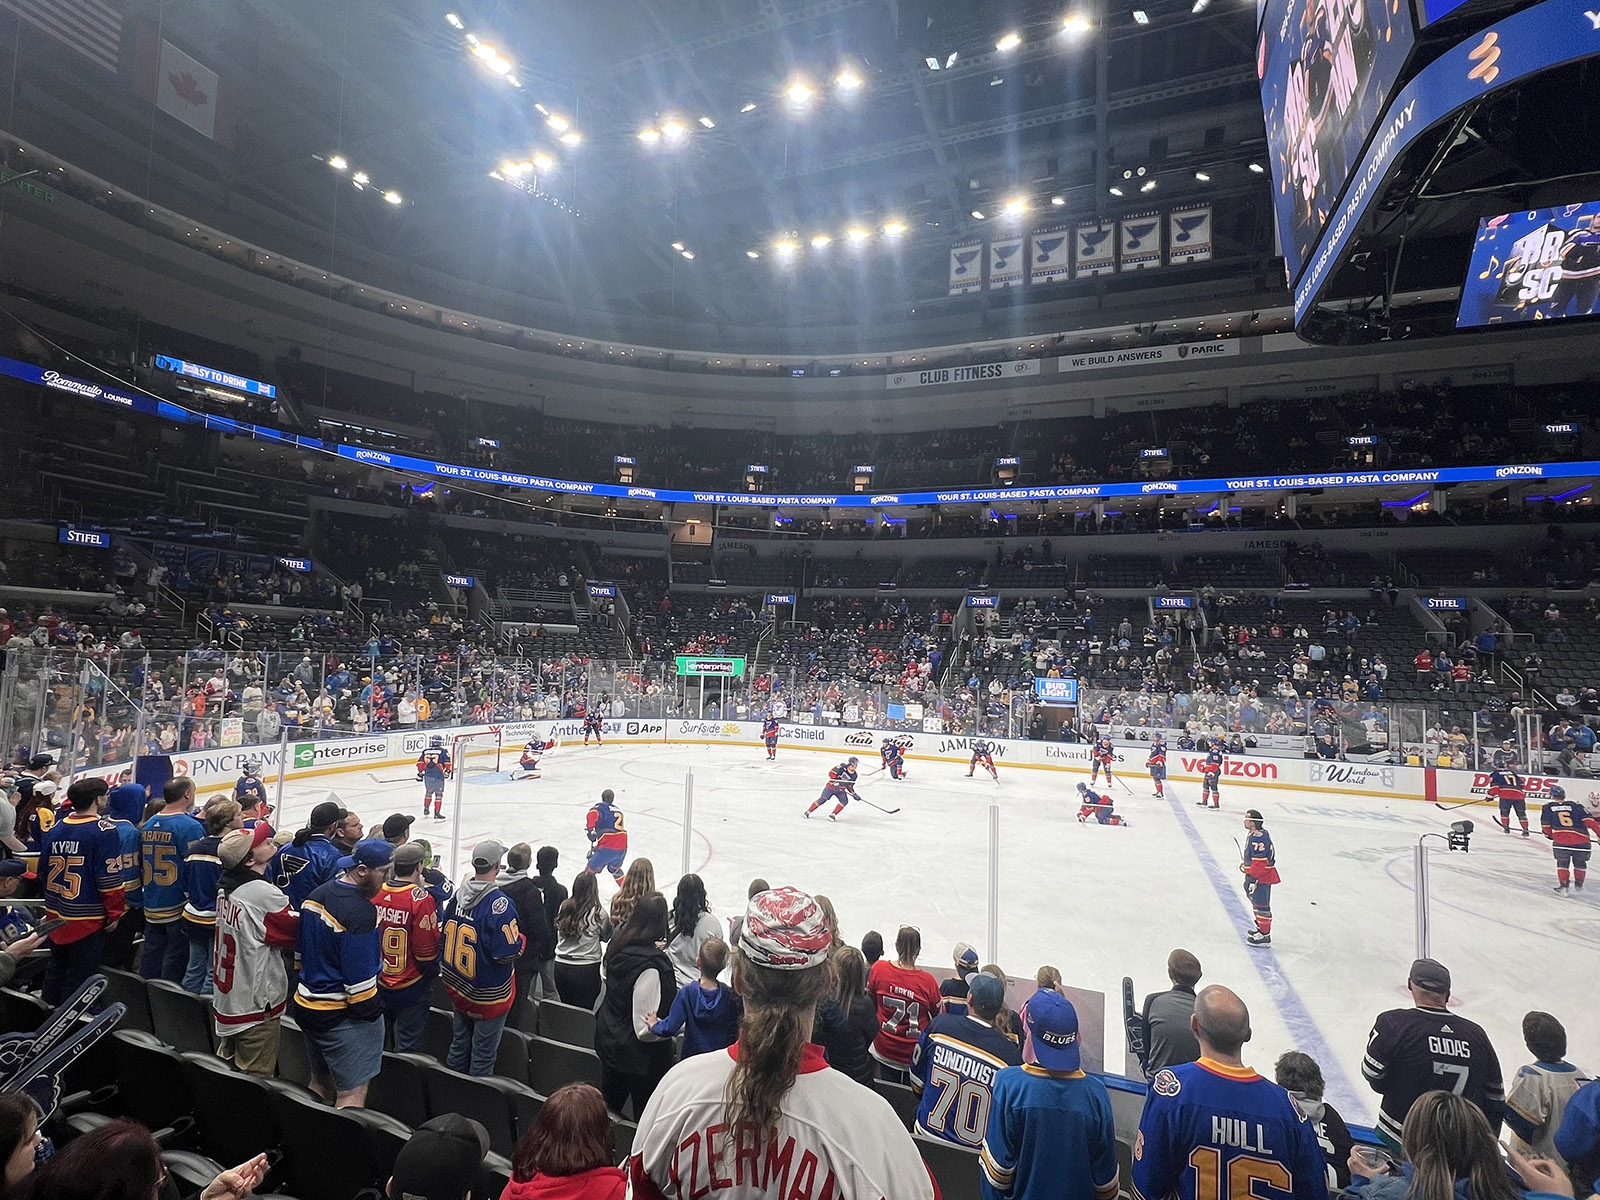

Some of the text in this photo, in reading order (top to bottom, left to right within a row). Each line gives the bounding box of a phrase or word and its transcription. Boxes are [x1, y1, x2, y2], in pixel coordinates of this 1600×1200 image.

[1347, 177, 1367, 222] PASTA
[1368, 99, 1416, 182] COMPANY
[1072, 344, 1225, 366] WE BUILD ANSWERS PARIC
[211, 371, 222, 382] TO
[222, 374, 248, 389] DRINK
[920, 365, 1002, 384] CLUB FITNESS
[103, 392, 133, 406] LOUNGE
[1545, 424, 1573, 433] STIFEL
[1349, 436, 1372, 445] STIFEL
[356, 450, 391, 464] RONZONI
[1143, 449, 1164, 457] STIFEL
[435, 465, 594, 492] YOUR ST. LOUIS-BASED PASTA COMPANY
[1495, 466, 1543, 478] RONZONI
[1226, 472, 1440, 489] YOUR ST. LOUIS-BASED PASTA COMPANY
[628, 488, 656, 498] RONZONI
[937, 487, 1101, 501] YOUR ST. LOUIS-BASED PASTA COMPANY
[1142, 483, 1178, 492] RONZONI
[715, 494, 726, 502] ST.
[727, 496, 776, 504] LOUIS-BASED
[776, 496, 800, 504] PASTA
[800, 496, 837, 504] COMPANY
[870, 495, 898, 504] RONZONI
[66, 530, 102, 545] STIFEL
[1244, 540, 1290, 549] JAMESO
[280, 558, 306, 569] STIFEL
[446, 575, 469, 586] STIFEL
[590, 586, 612, 596] STIFEL
[770, 594, 791, 604] STIFEL
[970, 597, 993, 606] STIFEL
[1160, 597, 1186, 607] STIFEL
[1428, 598, 1459, 608] STIFEL
[687, 662, 732, 671] enterprise
[1045, 681, 1067, 690] BUD
[1041, 689, 1071, 698] LIGHT
[549, 724, 587, 736] Anthe
[680, 721, 720, 734] Surfside
[406, 739, 424, 752] BJC
[845, 734, 873, 745] Club
[890, 738, 914, 748] lub
[301, 743, 386, 762] enterprise
[1046, 746, 1125, 763] Edward Jes
[192, 754, 233, 777] PNC
[1181, 756, 1278, 779] veizon
[1473, 773, 1559, 793] DBS
[1504, 775, 1517, 786] 17
[1557, 811, 1574, 827] 6
[142, 831, 171, 843] ARAYKO
[52, 841, 79, 854] KYROU
[143, 845, 177, 886] 55
[47, 856, 85, 900] 25
[444, 919, 478, 980] 16
[881, 997, 922, 1037] 71
[1042, 1032, 1076, 1045] BLUES
[1428, 1036, 1471, 1059] GUDAS
[1433, 1061, 1470, 1097] 7
[927, 1065, 992, 1146] 70
[1212, 1115, 1273, 1154] HULL
[1189, 1145, 1293, 1200] 16
